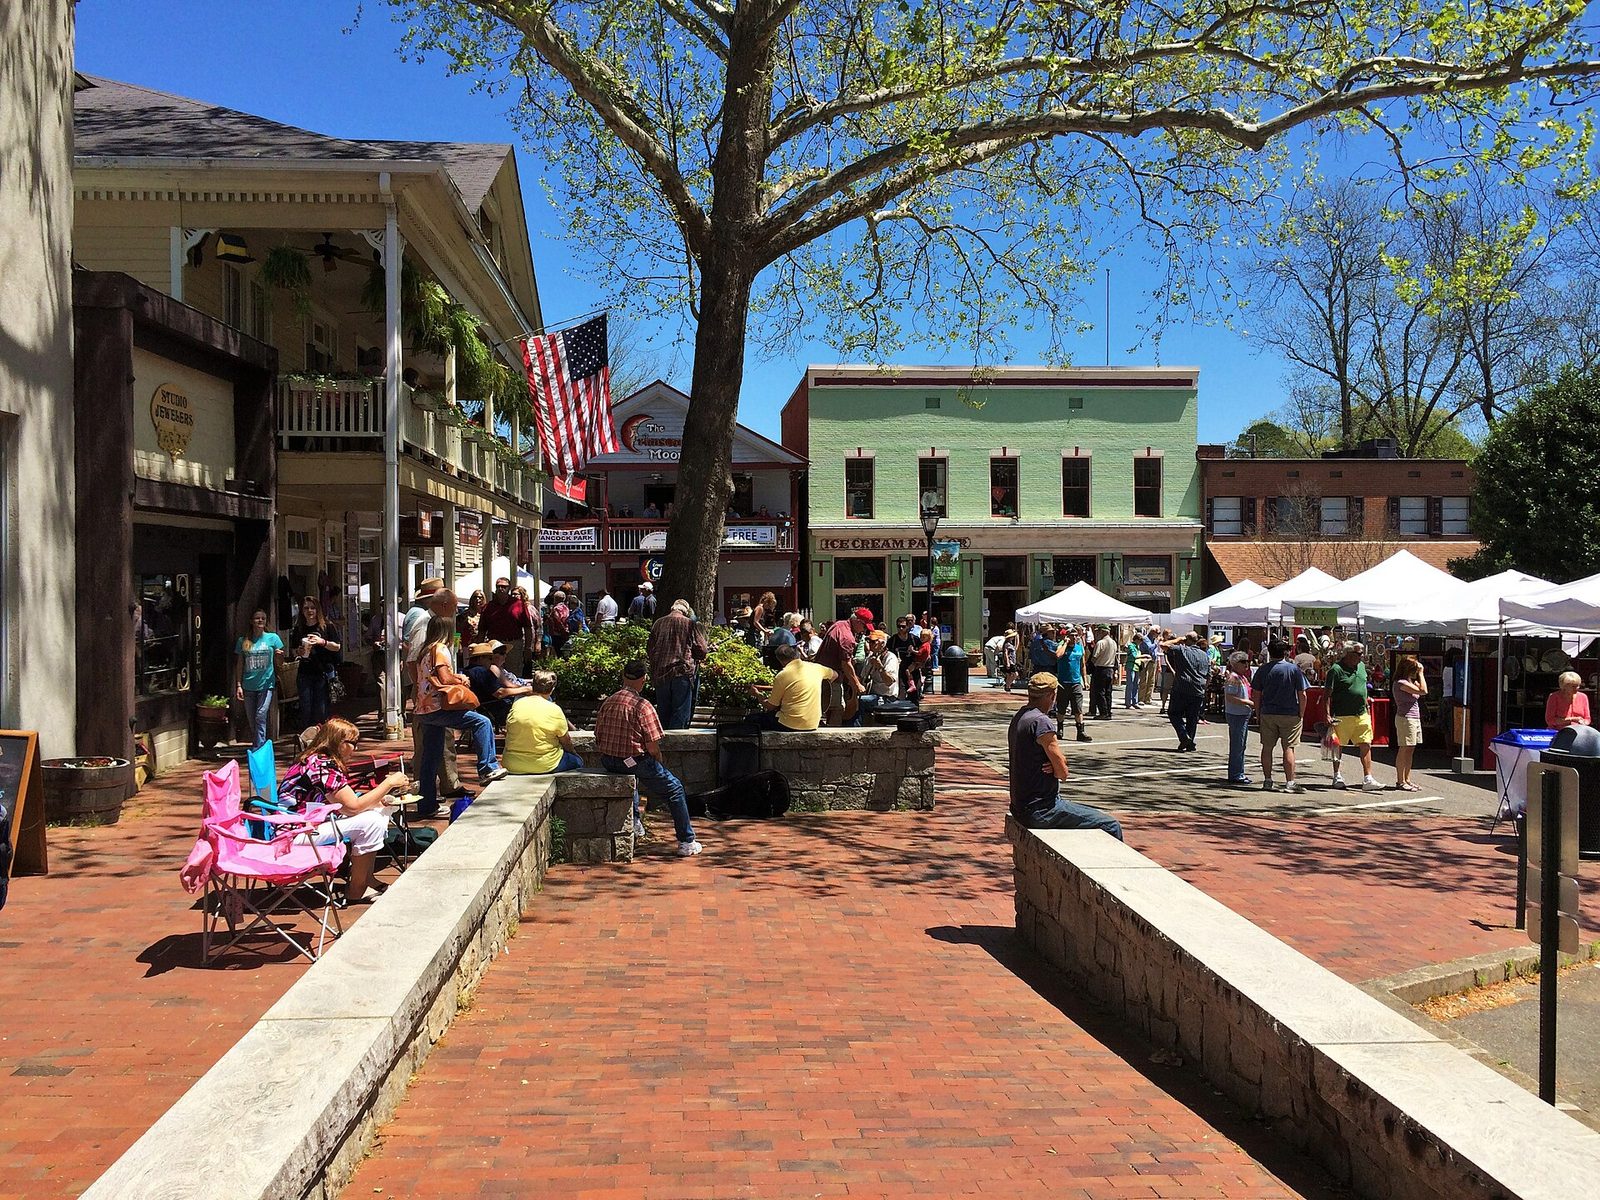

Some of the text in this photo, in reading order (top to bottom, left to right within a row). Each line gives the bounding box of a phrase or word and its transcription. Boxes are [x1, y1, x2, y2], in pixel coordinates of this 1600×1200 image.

[161, 389, 188, 409] STUDIO
[155, 405, 194, 427] JEWELERS
[646, 424, 665, 433] The
[732, 531, 758, 541] FREE
[824, 539, 850, 548] ICE
[851, 539, 904, 549] CREAM
